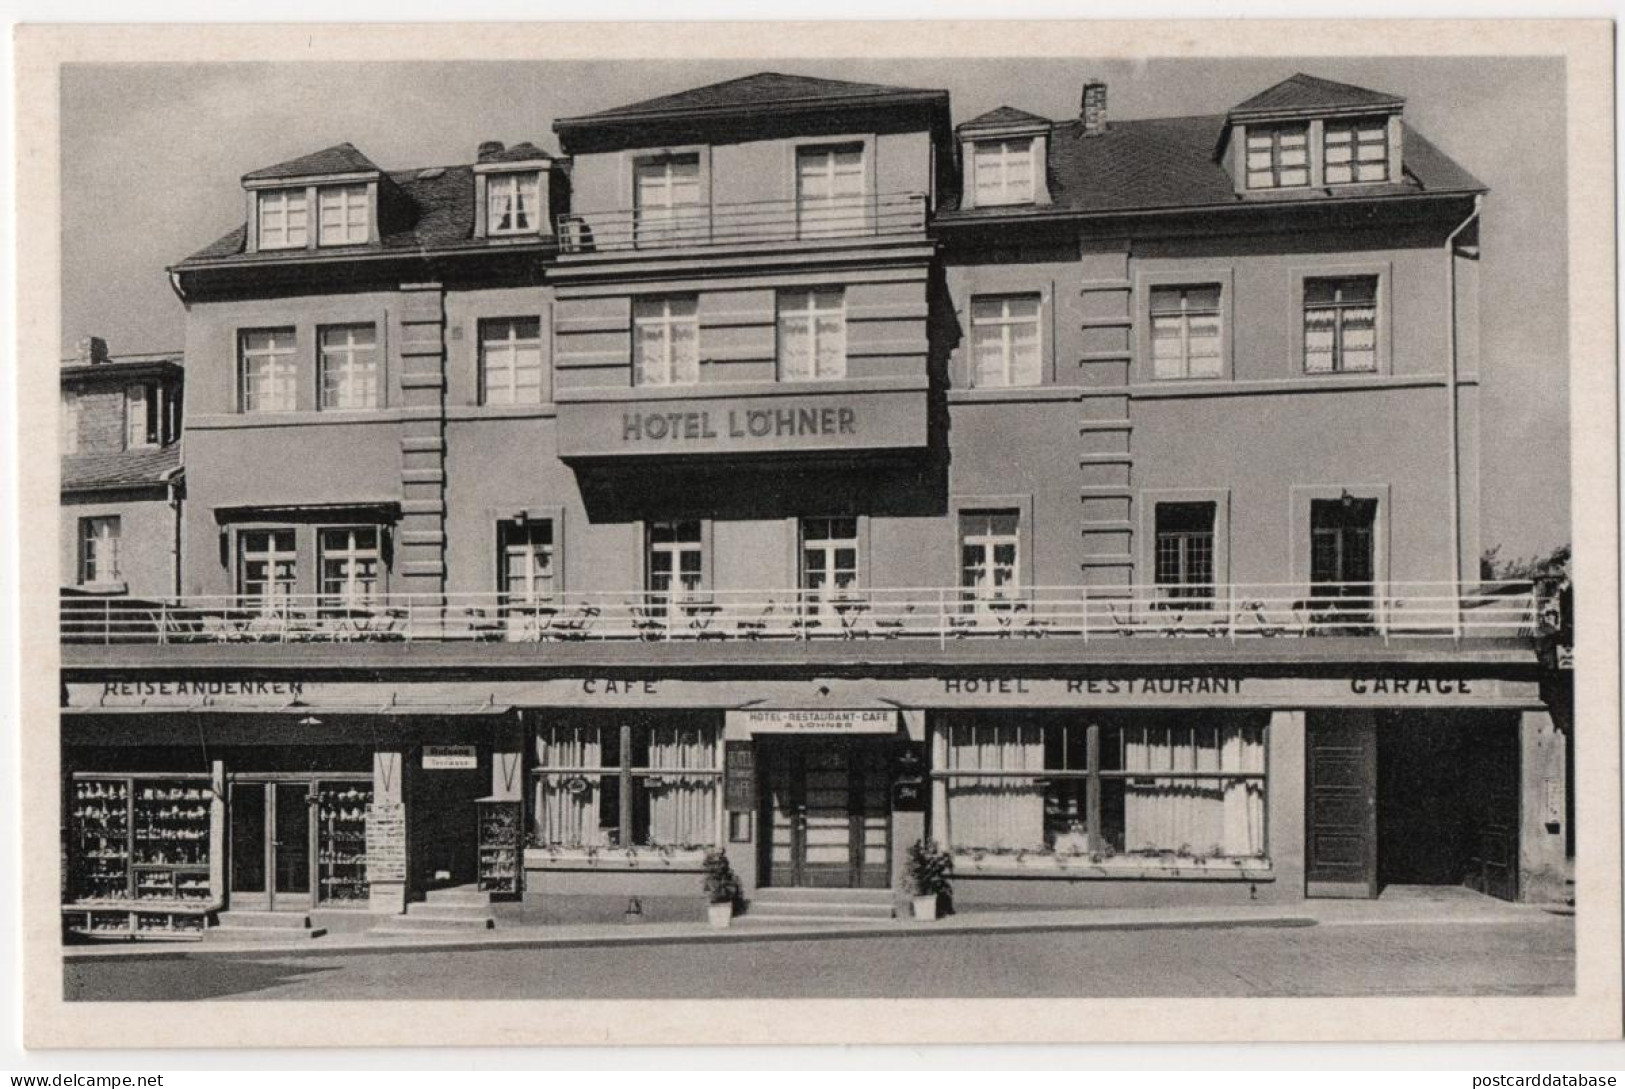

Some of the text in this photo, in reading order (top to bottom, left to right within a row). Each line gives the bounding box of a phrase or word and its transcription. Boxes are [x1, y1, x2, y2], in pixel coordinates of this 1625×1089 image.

[622, 407, 857, 441] HOTEL LÖHNER
[104, 681, 304, 696] REISEANDENKEN
[944, 679, 1243, 694] HOTEL RESTAURANT
[1350, 679, 1472, 694] GARAGE
